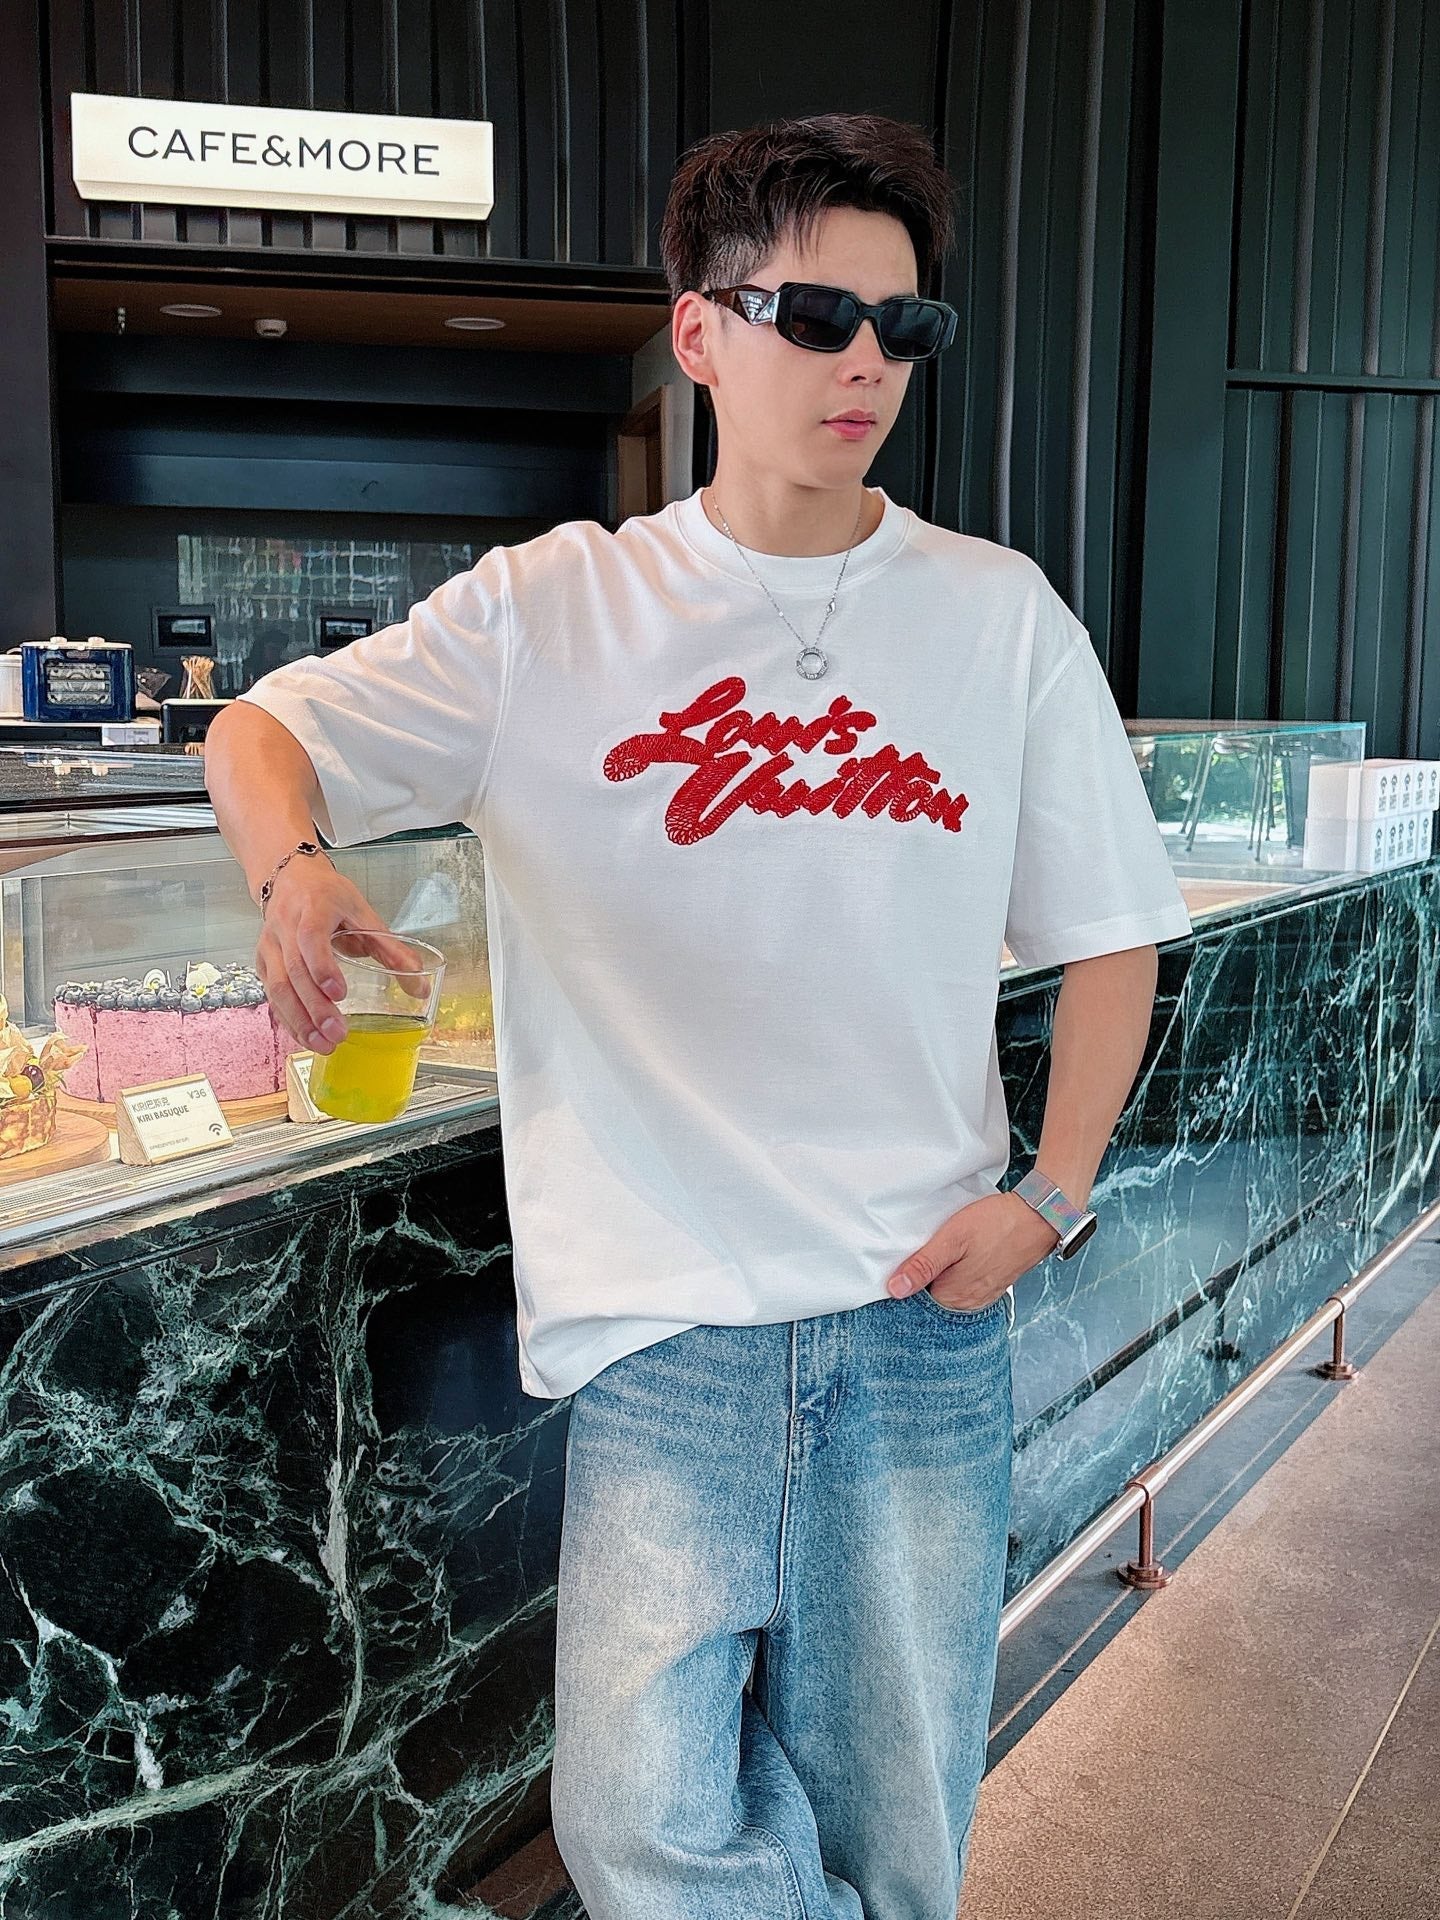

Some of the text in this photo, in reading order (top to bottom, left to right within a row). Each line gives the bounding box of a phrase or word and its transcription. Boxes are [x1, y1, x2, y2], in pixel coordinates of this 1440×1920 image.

[127, 125, 441, 177] CAFE&MORE
[136, 1104, 190, 1124] KIRI BASUQUE
